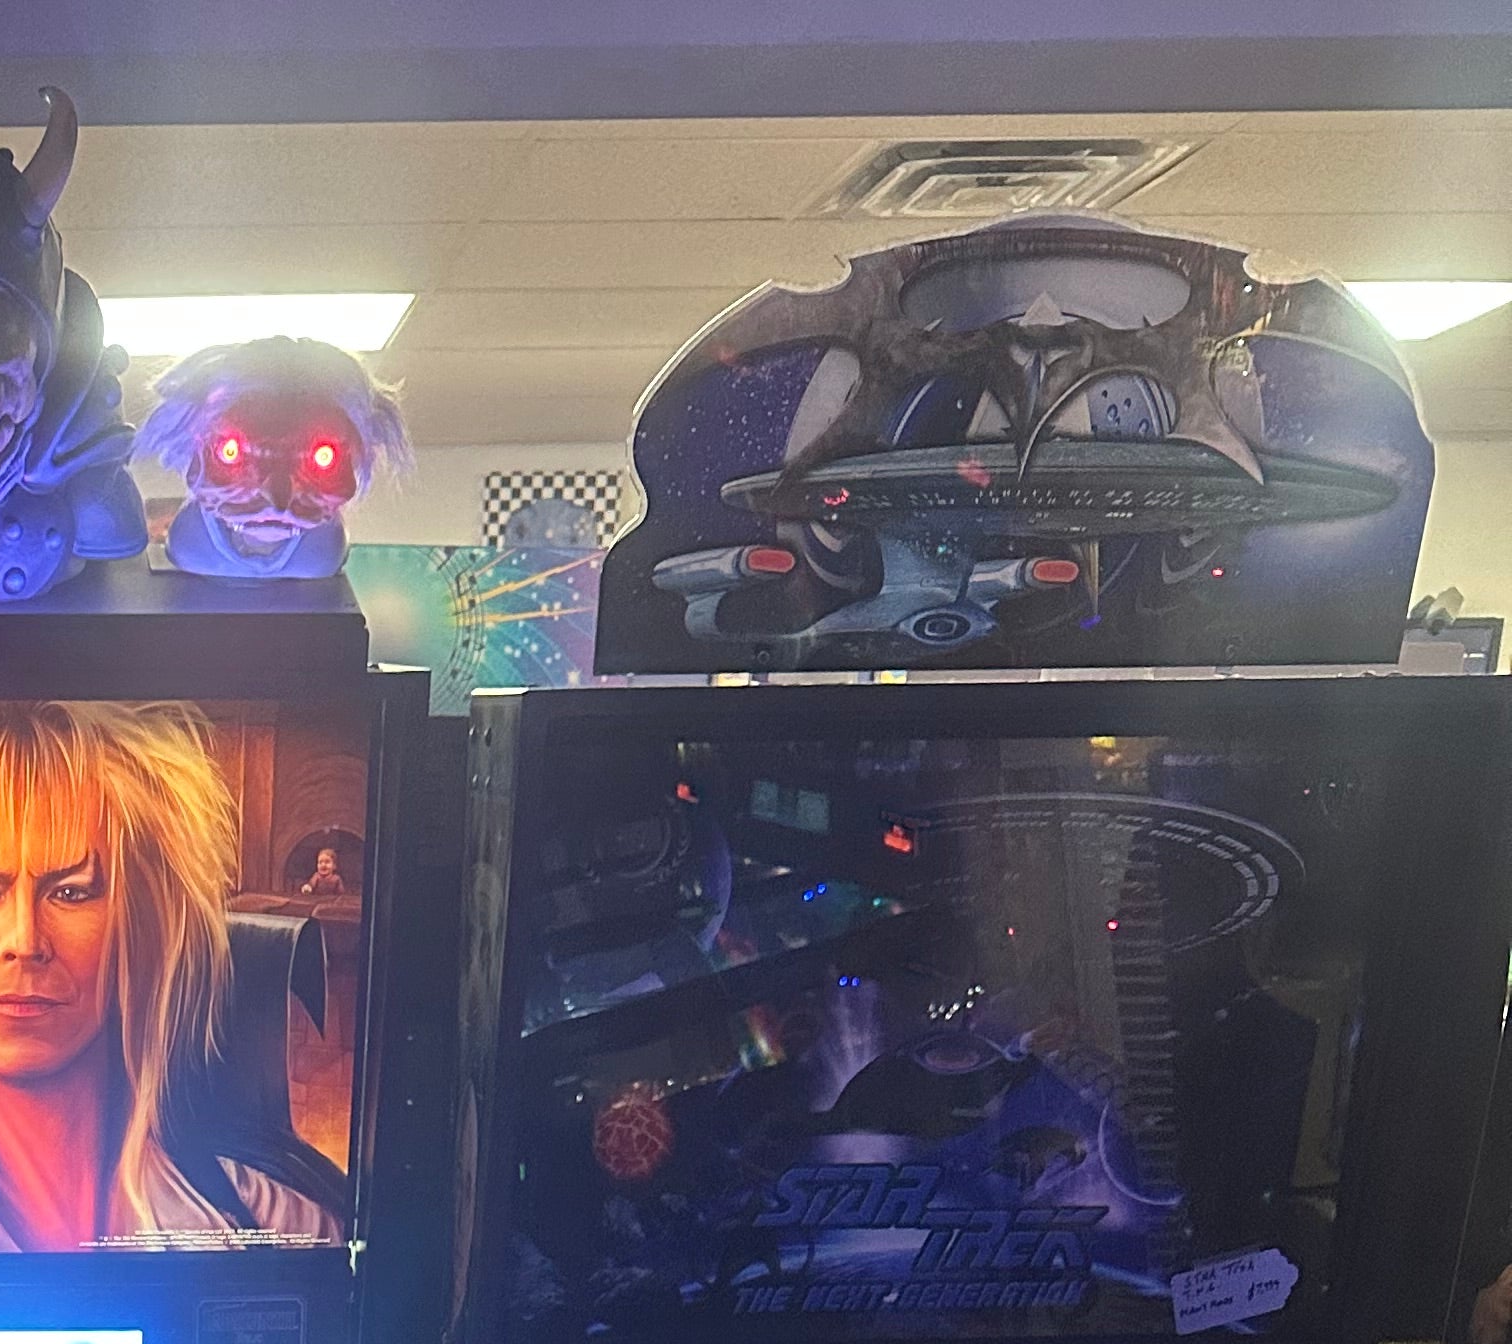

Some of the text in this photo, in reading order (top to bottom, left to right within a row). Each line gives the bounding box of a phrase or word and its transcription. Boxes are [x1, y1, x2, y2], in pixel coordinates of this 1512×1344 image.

[753, 1162, 944, 1226] STAR
[912, 1205, 1110, 1272] TREK
[734, 1280, 1091, 1315] THE NEXT GENERATION
